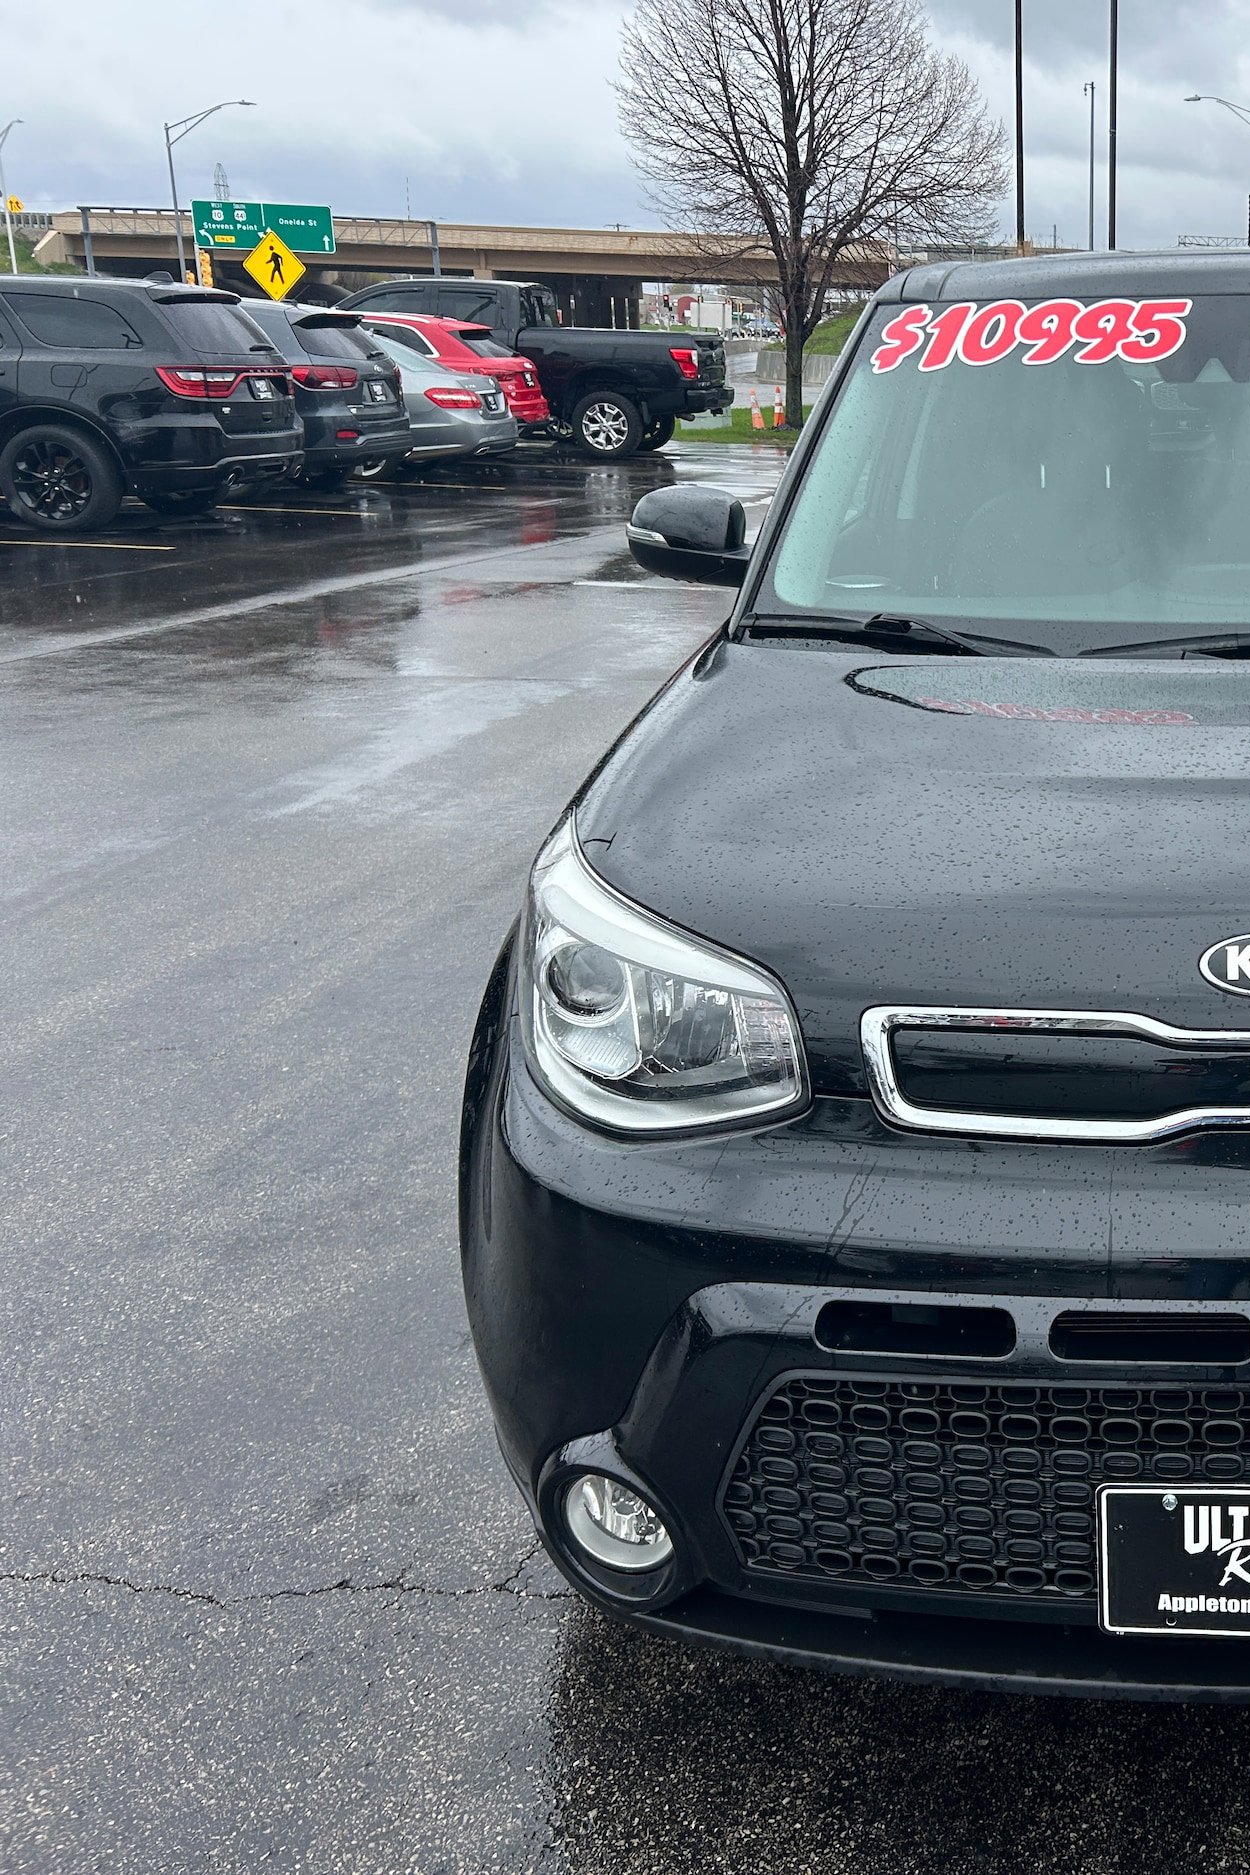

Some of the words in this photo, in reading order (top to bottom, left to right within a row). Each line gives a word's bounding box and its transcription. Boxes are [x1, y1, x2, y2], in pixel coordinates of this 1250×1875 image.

[203, 222, 234, 230] Stevens
[236, 223, 258, 231] Point
[278, 218, 305, 226] Oneida
[308, 219, 317, 227] St
[870, 299, 1193, 374] $10995
